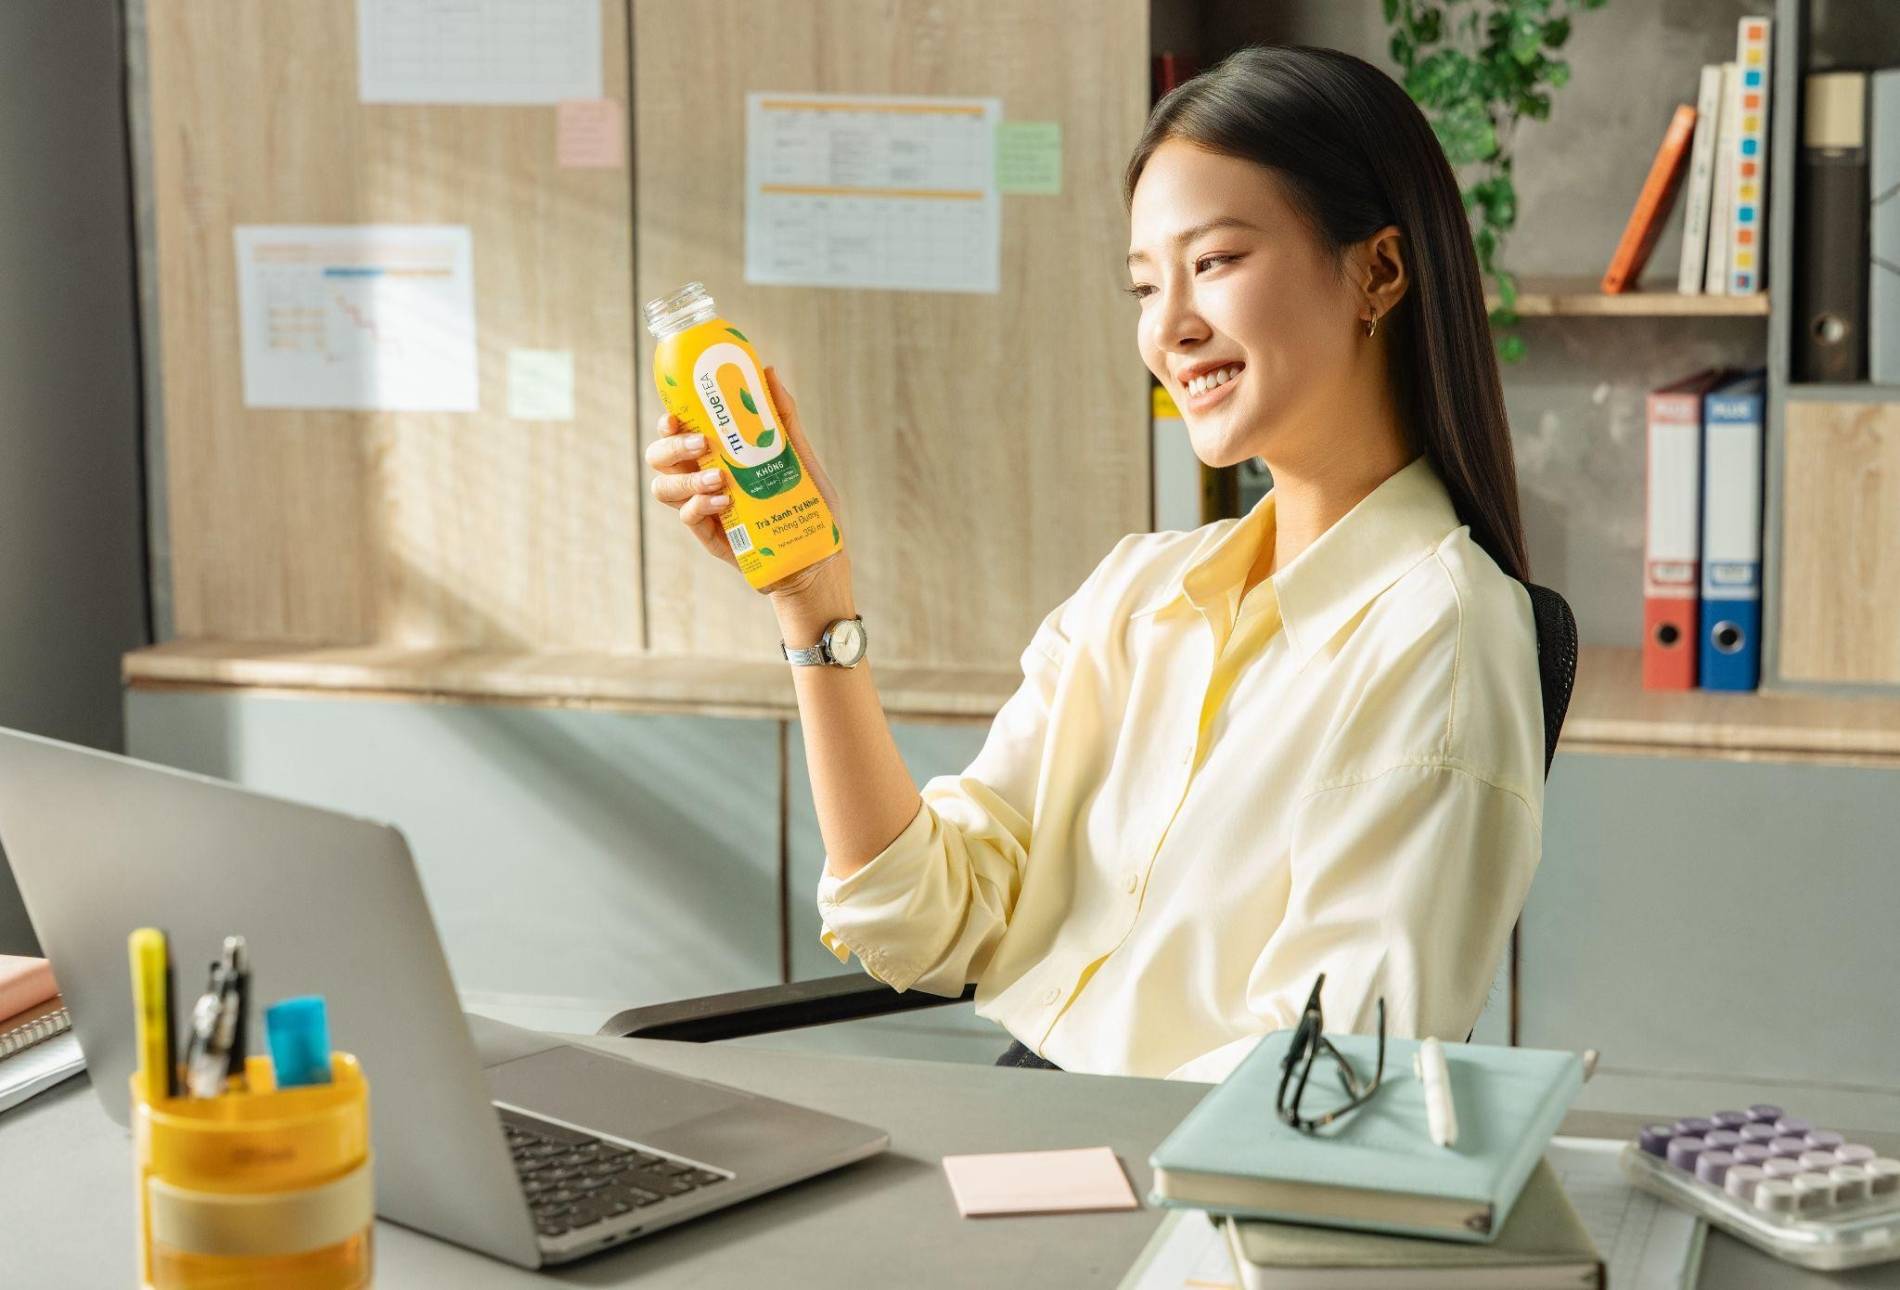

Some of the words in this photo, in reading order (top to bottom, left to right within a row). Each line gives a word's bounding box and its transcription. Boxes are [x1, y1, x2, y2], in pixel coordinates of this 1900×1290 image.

[727, 433, 743, 455] TH
[755, 460, 784, 478] KHÔNG
[770, 509, 793, 523] Xanh
